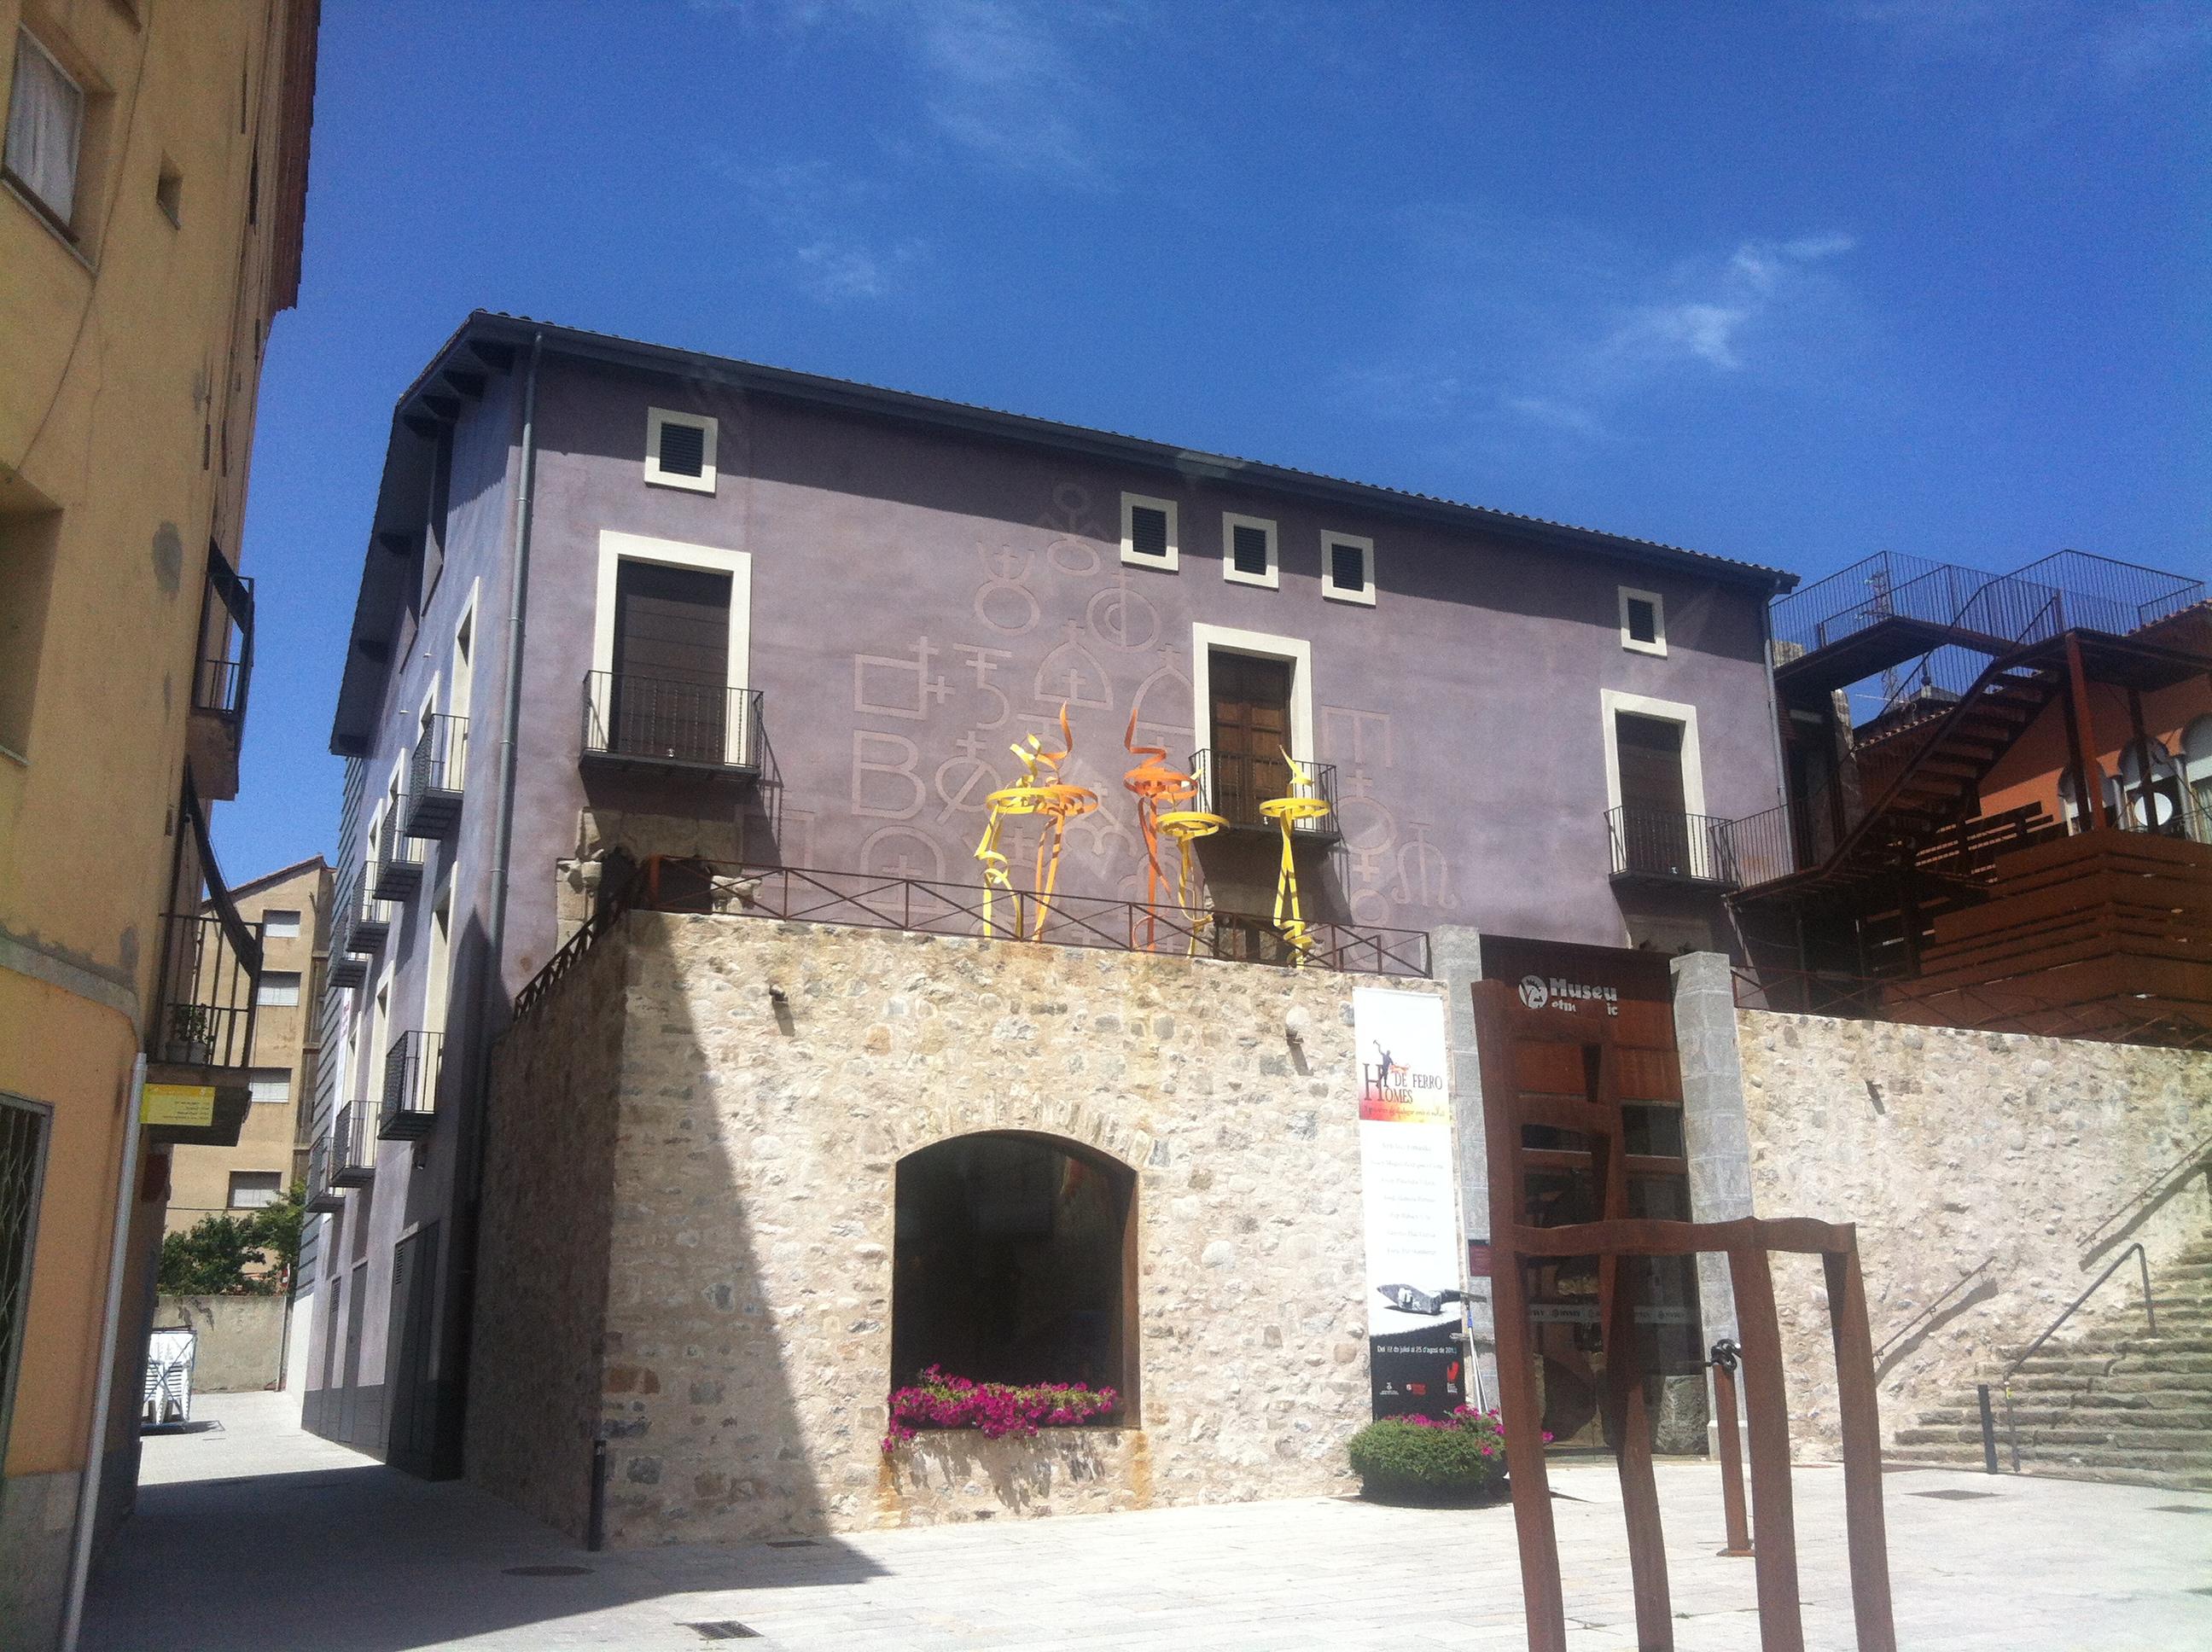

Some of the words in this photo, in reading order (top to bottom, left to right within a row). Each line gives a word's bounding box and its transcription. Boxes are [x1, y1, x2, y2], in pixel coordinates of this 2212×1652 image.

[1550, 977, 1617, 1001] Museu
[1394, 1072, 1406, 1088] DE
[1412, 1073, 1443, 1091] FERRO
